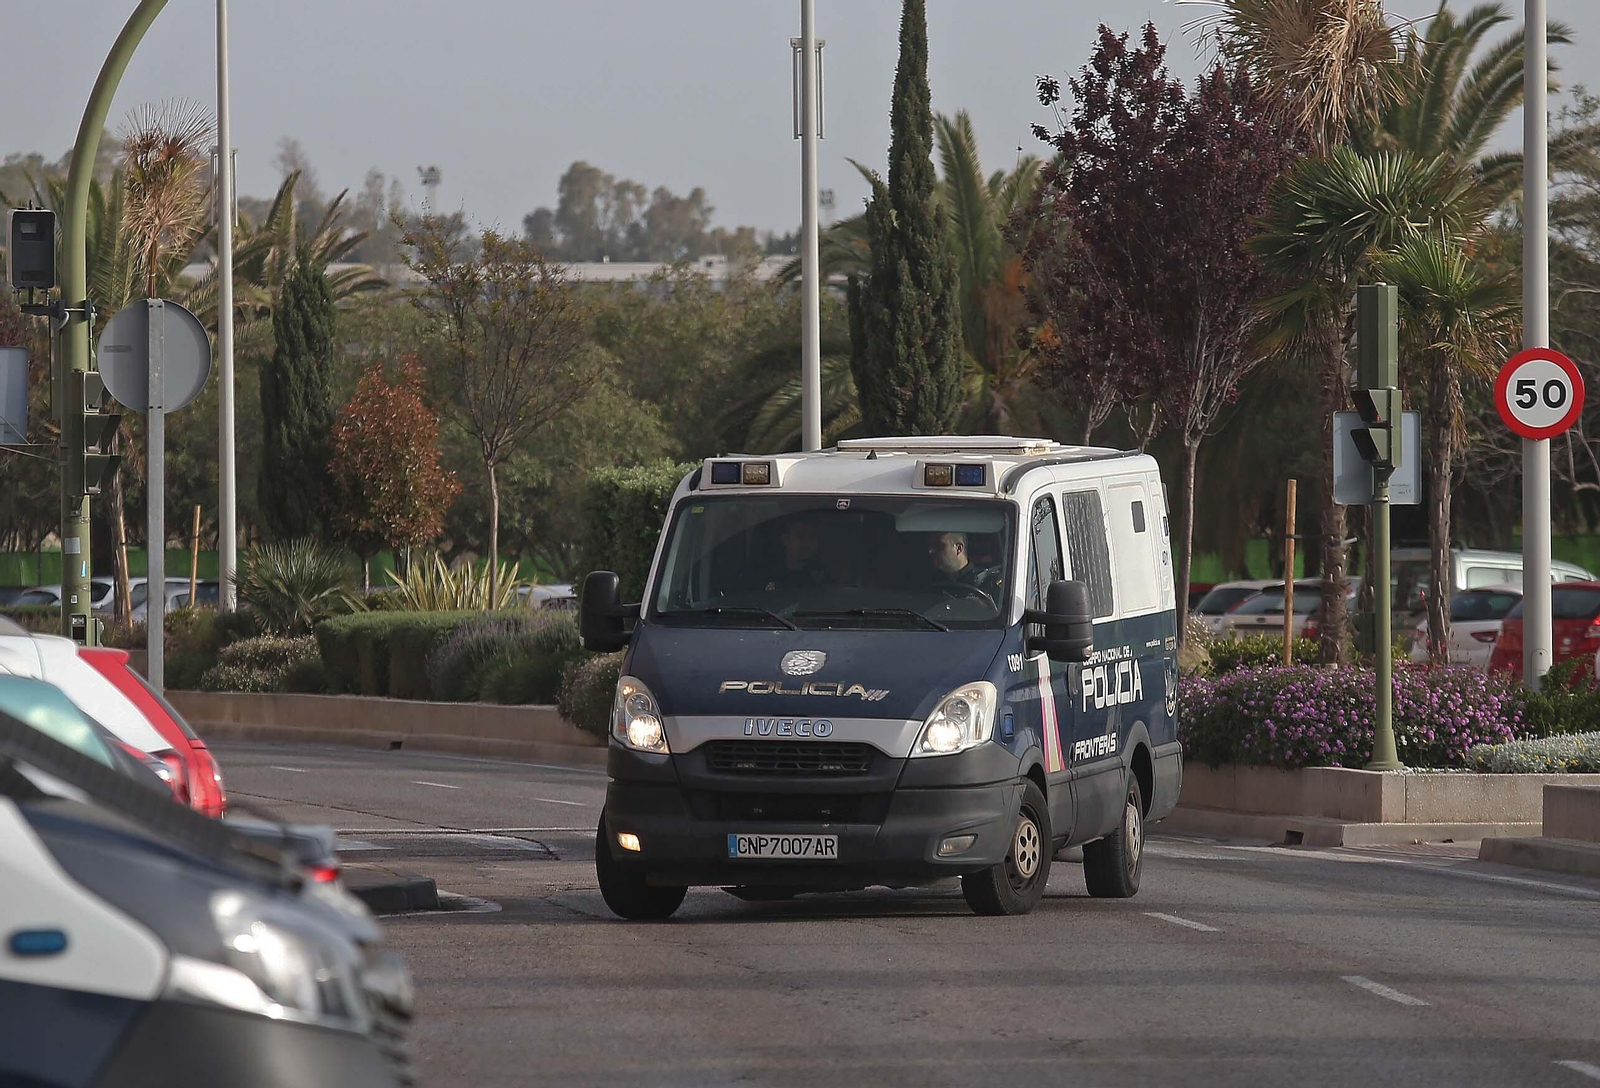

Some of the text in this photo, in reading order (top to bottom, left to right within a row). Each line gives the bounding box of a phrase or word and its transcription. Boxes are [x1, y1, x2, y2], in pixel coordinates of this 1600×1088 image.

[1515, 379, 1567, 410] 50
[744, 718, 833, 737] IVECO
[1074, 731, 1117, 762] FRONTERAS
